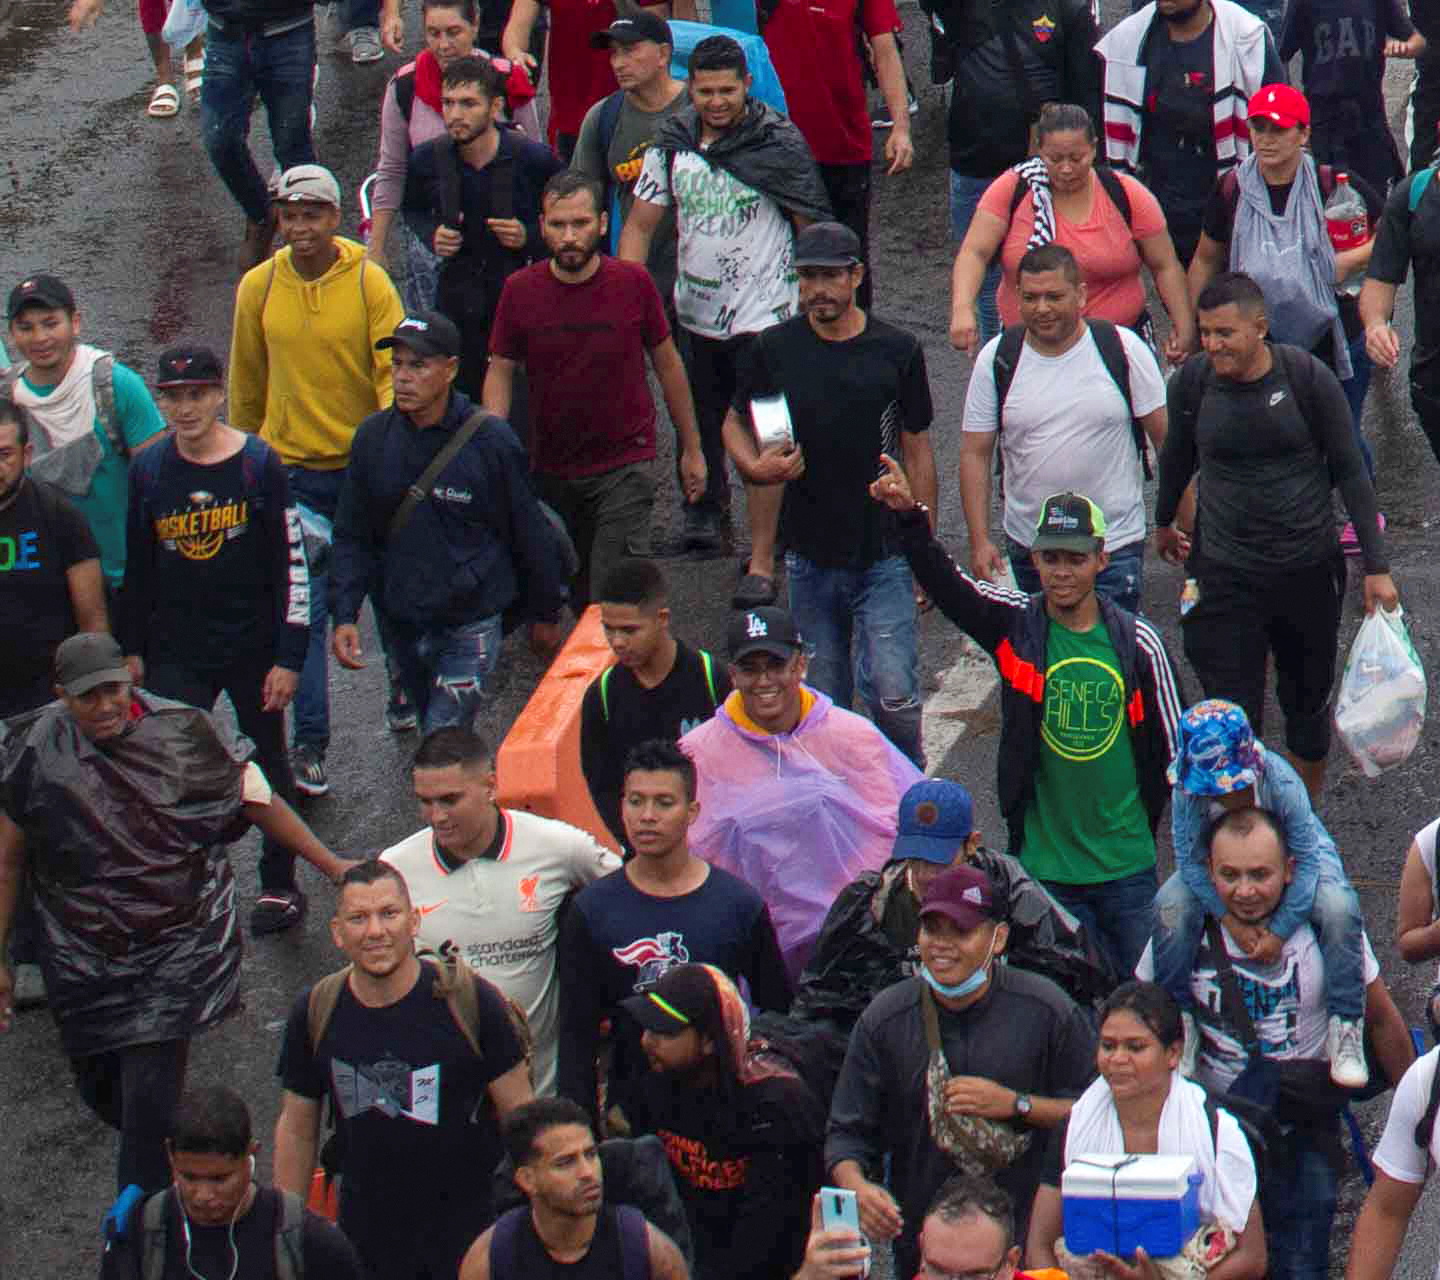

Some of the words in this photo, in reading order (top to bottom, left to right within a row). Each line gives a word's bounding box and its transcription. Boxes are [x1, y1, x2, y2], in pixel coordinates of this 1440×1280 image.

[1312, 17, 1377, 65] GAP
[745, 612, 769, 638] LA
[1047, 681, 1120, 706] SENECA
[1045, 700, 1113, 732] HILLS
